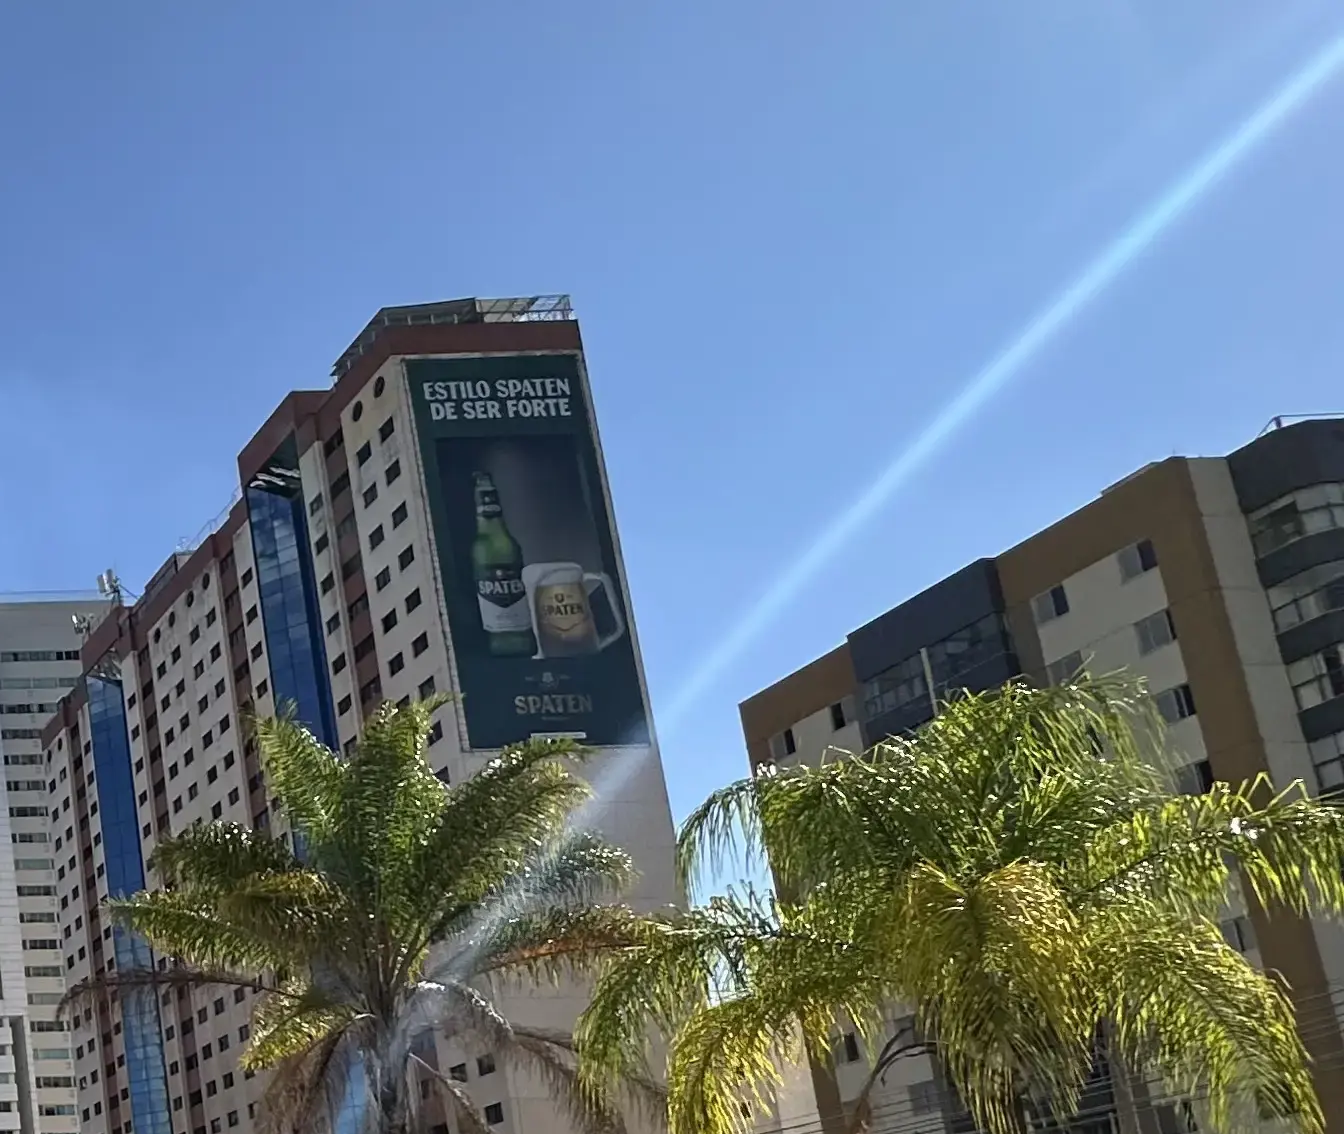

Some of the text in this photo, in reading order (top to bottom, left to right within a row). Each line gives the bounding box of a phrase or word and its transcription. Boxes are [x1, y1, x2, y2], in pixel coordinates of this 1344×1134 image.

[423, 378, 571, 400] ESTILO SPATEN
[430, 398, 572, 421] DE SER FORTE
[514, 694, 593, 715] SPATEN
